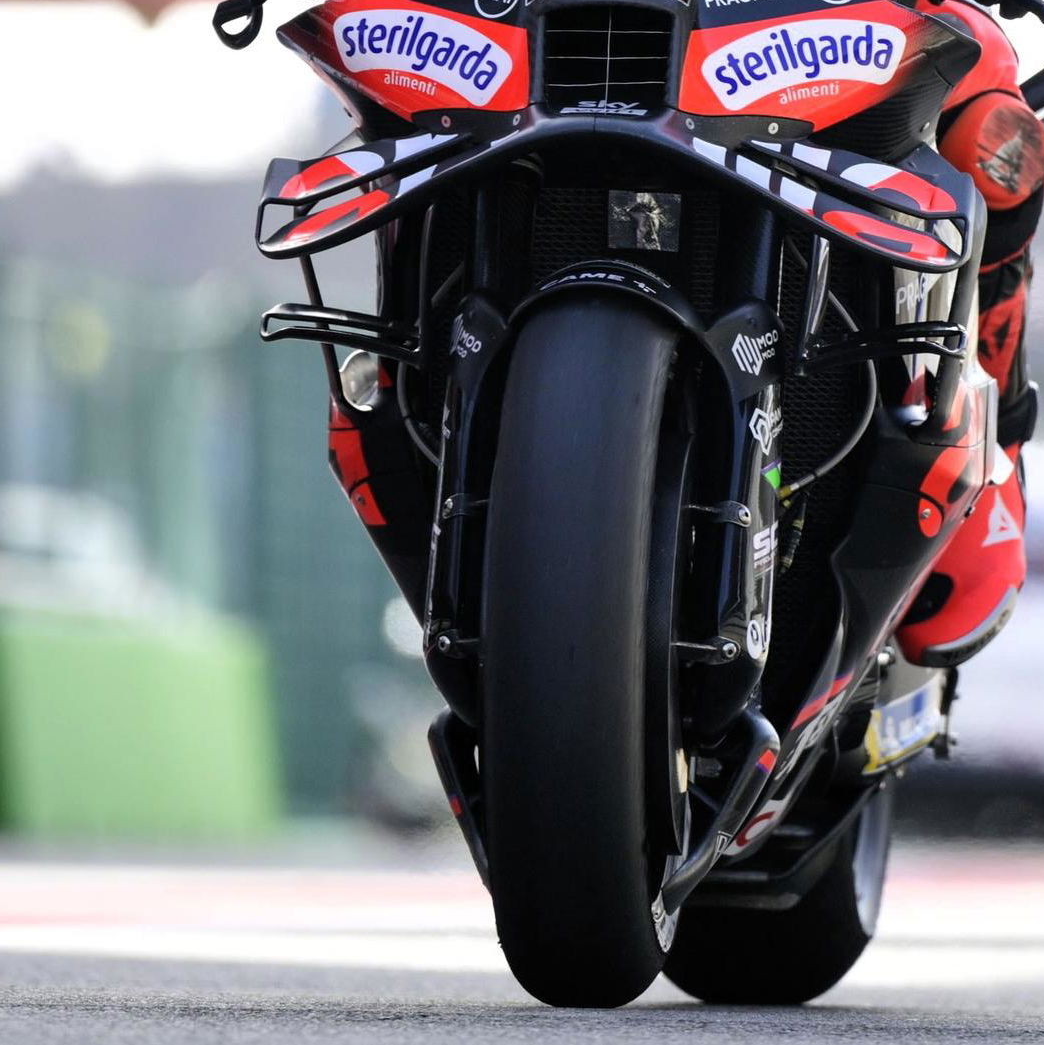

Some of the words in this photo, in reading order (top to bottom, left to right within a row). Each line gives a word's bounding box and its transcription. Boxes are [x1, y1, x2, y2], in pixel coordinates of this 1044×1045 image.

[342, 15, 498, 91] sterilgarda
[715, 24, 893, 96] sterilgarda
[384, 70, 437, 96] alimenti
[779, 81, 840, 105] alimenti
